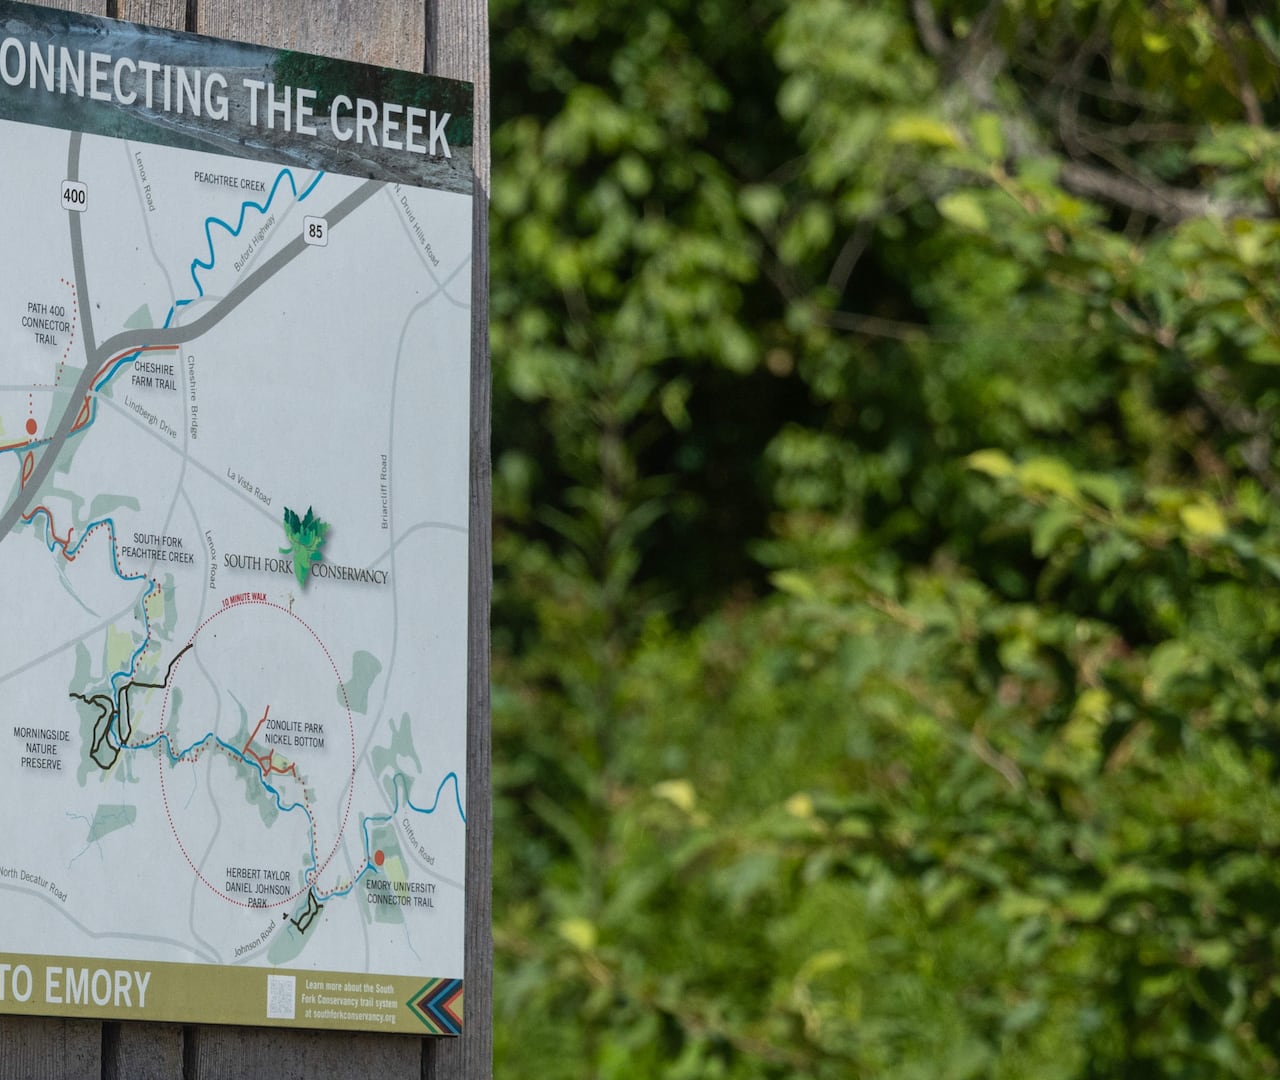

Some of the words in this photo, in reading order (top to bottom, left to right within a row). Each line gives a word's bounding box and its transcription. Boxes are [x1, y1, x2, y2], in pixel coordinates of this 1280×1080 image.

[243, 79, 317, 135] THE
[330, 94, 452, 158] CREEK
[135, 152, 146, 182] Lenox
[144, 185, 155, 212] Road
[194, 171, 238, 188] PEACHTREE
[241, 179, 265, 191] CREEK
[64, 189, 85, 203] 400
[309, 224, 322, 238] 85
[394, 184, 402, 194] N.
[401, 196, 414, 220] Druid
[414, 222, 425, 245] Hills
[424, 244, 439, 266] Road
[28, 303, 47, 314] PATH
[49, 306, 64, 316] 400
[22, 317, 70, 332] CONNECTOR
[35, 333, 57, 346] TRAIL
[135, 361, 174, 375] CHESHIRE
[132, 376, 152, 387] FARM
[155, 378, 176, 390] TRAIL
[124, 396, 158, 425] Lindbergh
[159, 420, 177, 438] Drive
[134, 533, 160, 545] SOUTH
[162, 536, 182, 547] FORK
[122, 546, 166, 561] PEACHTREE
[168, 552, 194, 563] CREEK
[224, 553, 261, 571] SOUTH
[265, 558, 293, 573] FORK
[312, 563, 389, 584] CONSERVANCY
[230, 594, 250, 603] MINUTE
[252, 593, 267, 601] WALK
[266, 719, 302, 732] ZONOLITE
[304, 722, 323, 733] PARK
[14, 727, 70, 741] MORNINGSIDE
[265, 734, 292, 745] NICKEL
[295, 736, 324, 747] BOTTOM
[26, 743, 57, 755] NATURE
[21, 757, 61, 770] PRESERVE
[227, 867, 261, 879] HERBERT
[264, 869, 290, 880] TAYLOR
[21, 870, 48, 888] Decatur
[50, 884, 67, 902] Road
[226, 882, 253, 893] DANIEL
[255, 883, 290, 895] JOHNSON
[367, 880, 391, 890] EMORY
[394, 882, 435, 894] UNIVERSITY
[248, 897, 267, 907] PARK
[368, 894, 411, 905] CONNECTOR
[413, 896, 434, 907] TRAIL
[46, 966, 151, 1008] EMORY
